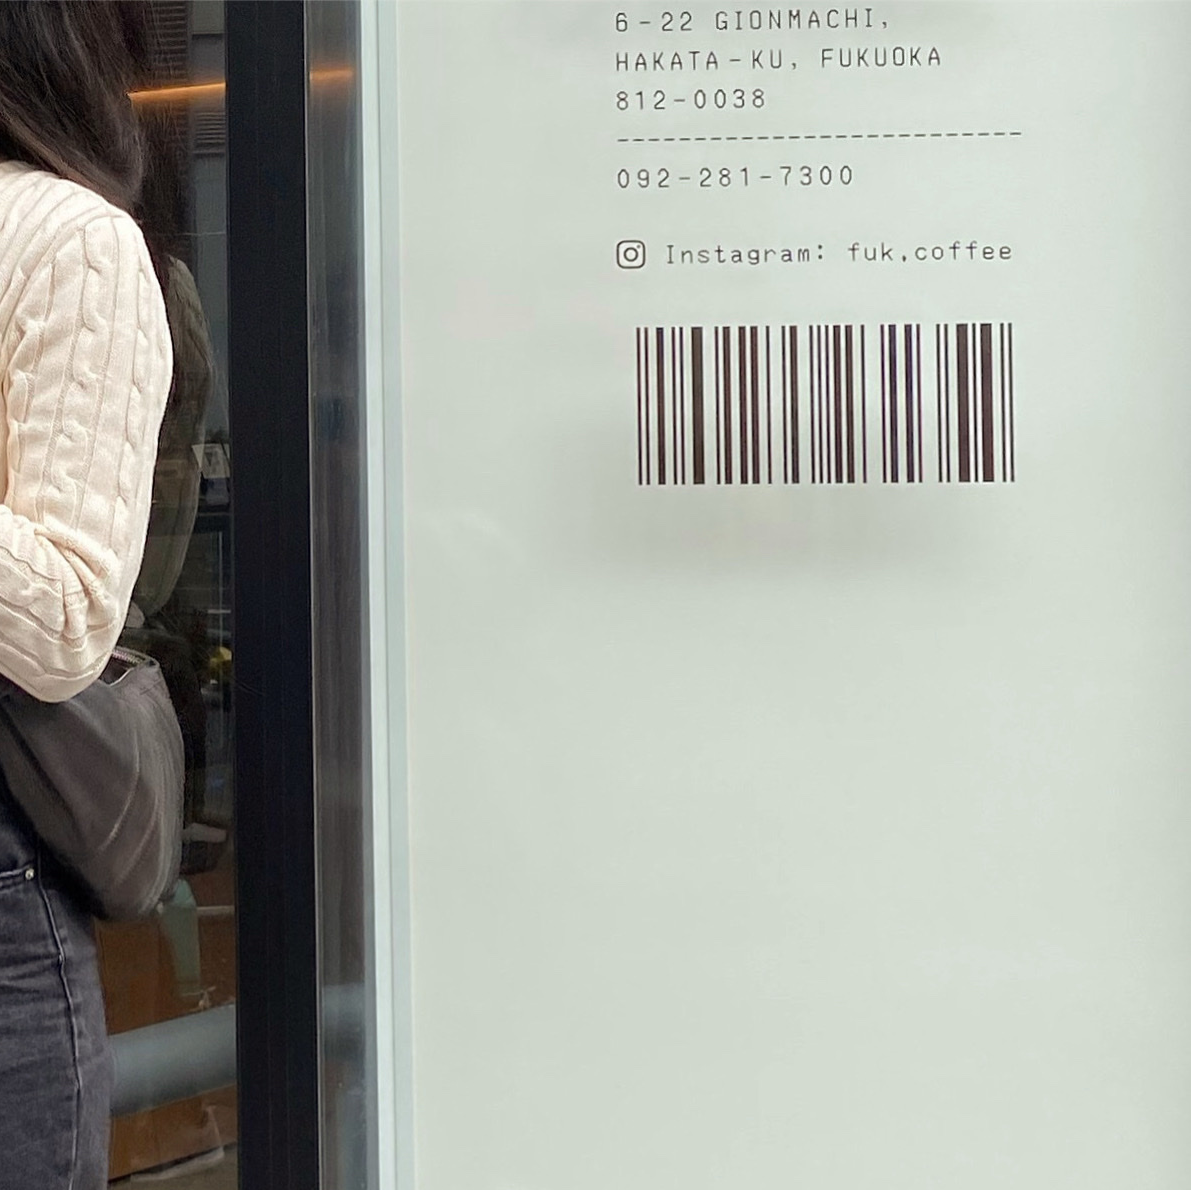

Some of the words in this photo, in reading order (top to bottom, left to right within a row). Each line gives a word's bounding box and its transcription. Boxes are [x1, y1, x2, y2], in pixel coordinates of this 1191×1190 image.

[615, 11, 693, 32] 6-22
[715, 7, 888, 31] GIONMACHI,
[615, 48, 797, 71] HAKATA-KU,
[821, 46, 941, 68] FUKUOKA
[616, 87, 765, 111] 812-0038
[617, 164, 853, 189] 092-281-7300
[666, 243, 824, 266] Instagram:
